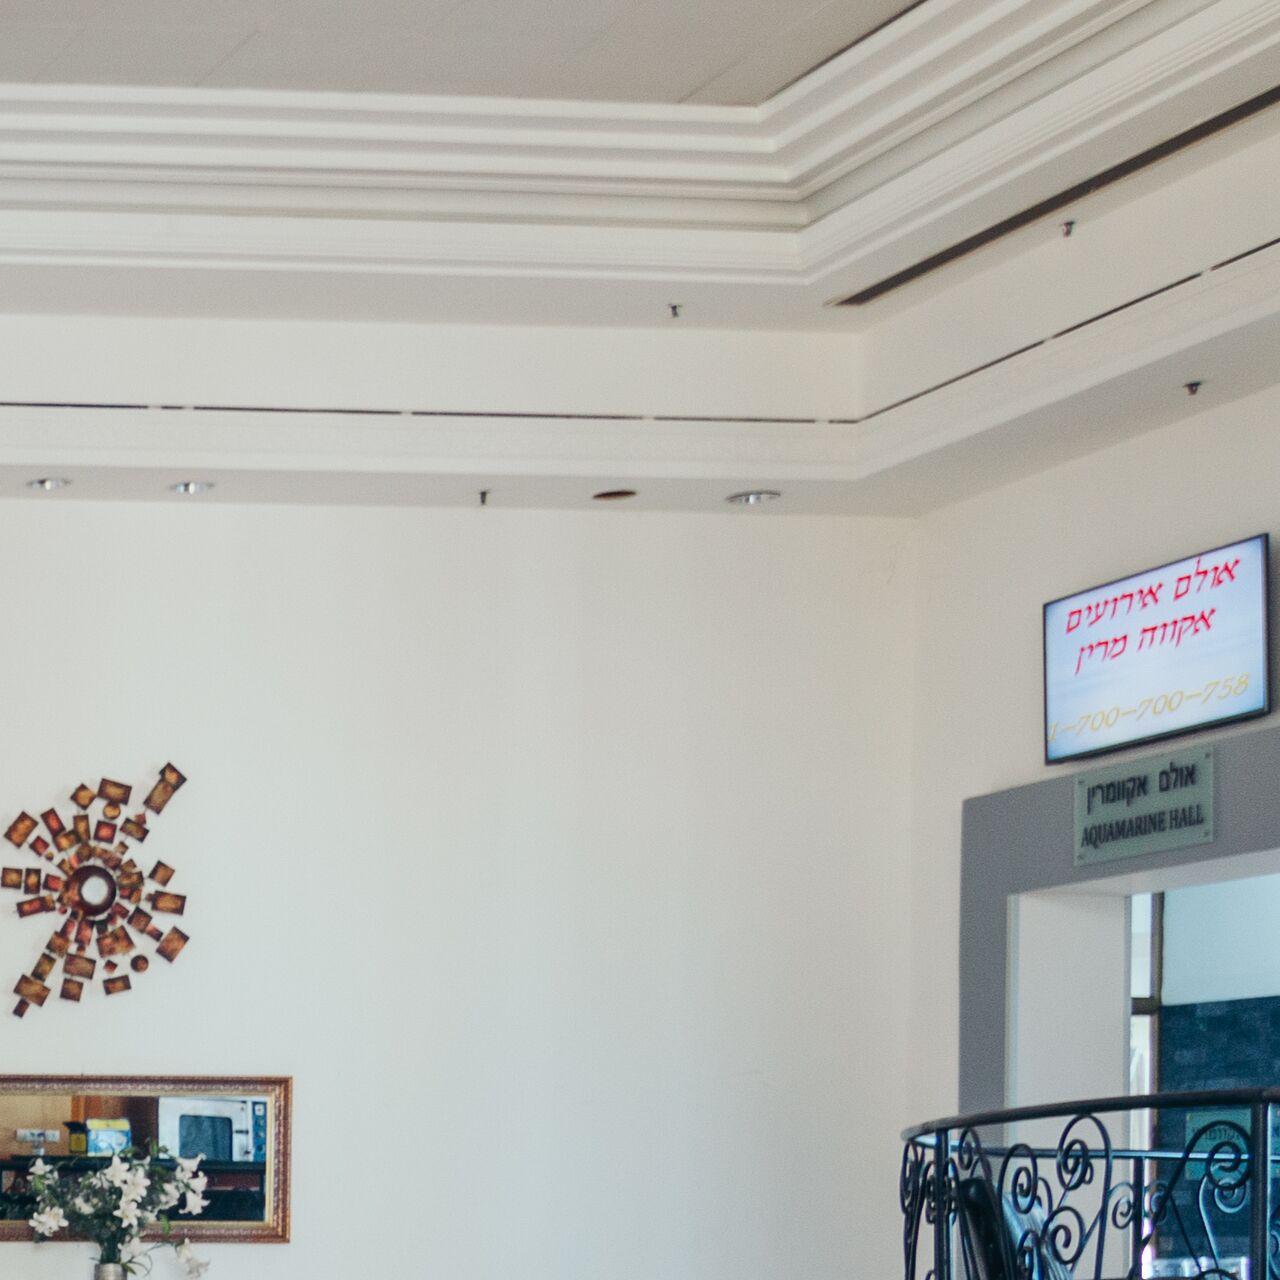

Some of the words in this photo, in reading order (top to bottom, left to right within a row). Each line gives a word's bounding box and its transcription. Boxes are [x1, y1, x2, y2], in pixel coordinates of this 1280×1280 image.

[1173, 556, 1241, 601] אולם
[1064, 581, 1164, 635] אירועים
[1136, 606, 1217, 649] אקווה
[1074, 634, 1128, 676] מרין
[1048, 671, 1250, 742] 1-700-700-758
[1158, 761, 1198, 794] אולם
[1080, 809, 1166, 850] AQUAMARINE
[1169, 803, 1205, 831] HALL
